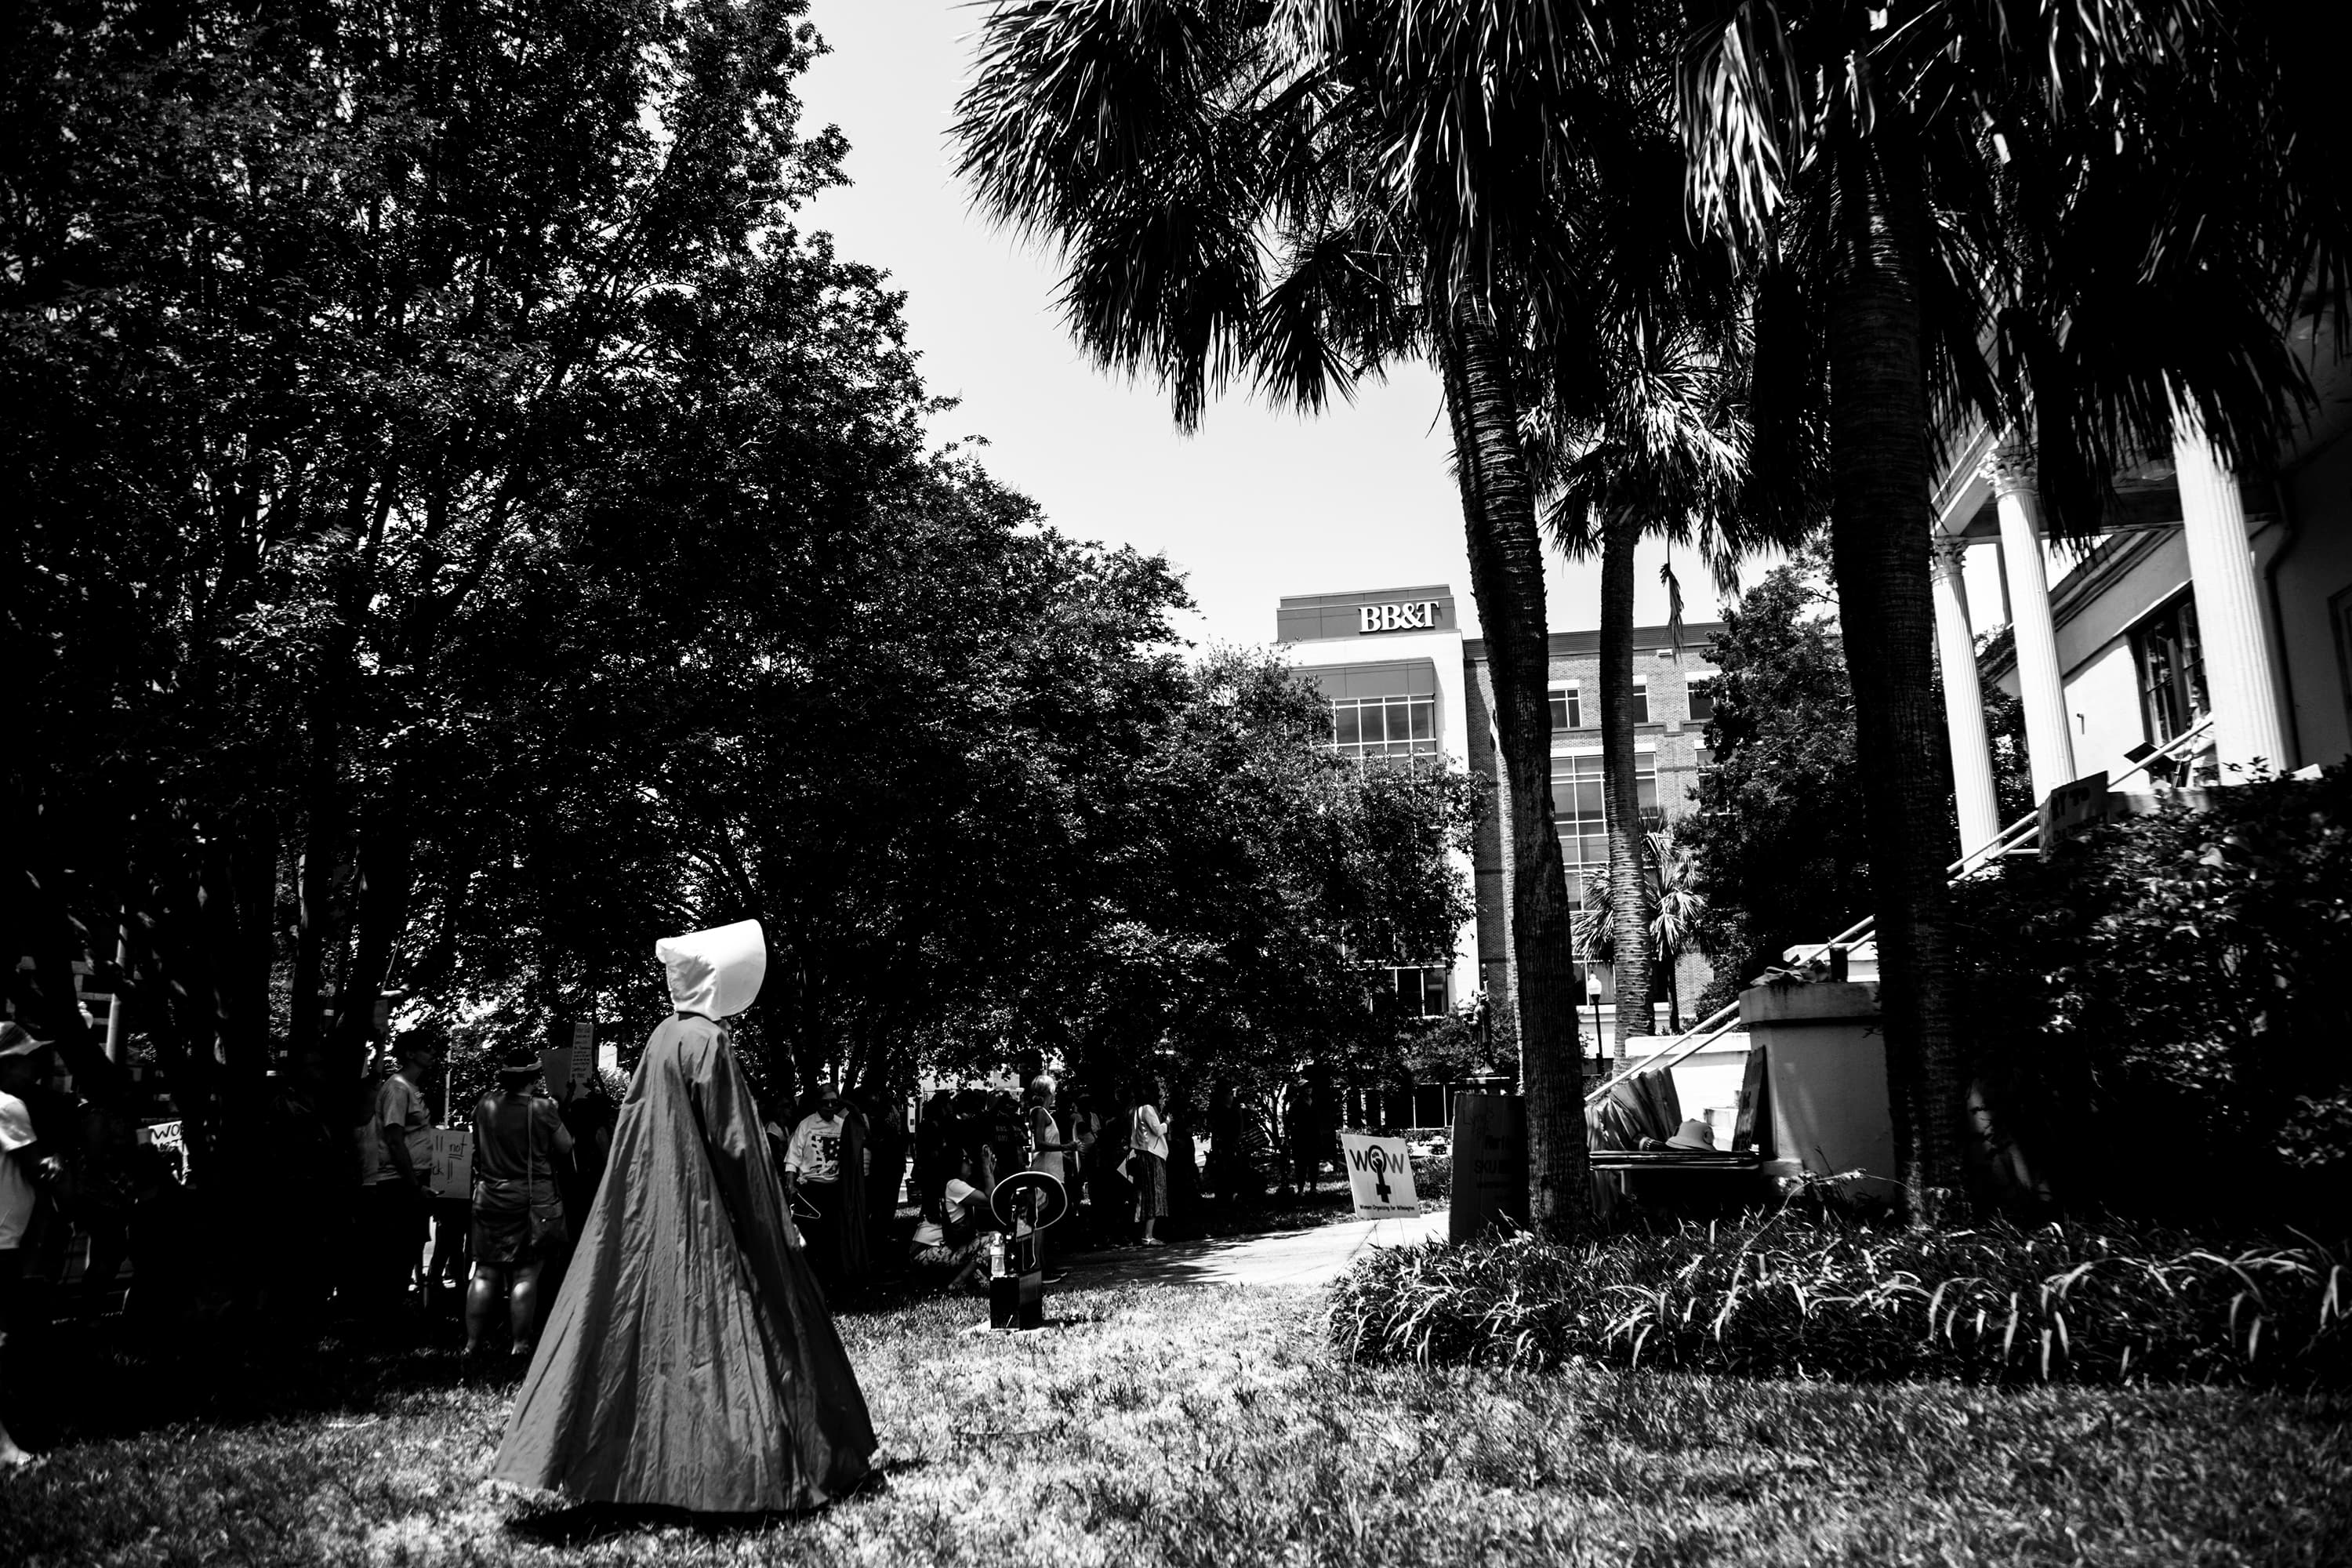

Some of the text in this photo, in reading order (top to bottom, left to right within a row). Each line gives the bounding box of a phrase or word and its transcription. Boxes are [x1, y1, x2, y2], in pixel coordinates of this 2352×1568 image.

[1358, 601, 1439, 633] BB&T
[450, 1134, 468, 1156] not
[1349, 1145, 1404, 1174] WOW
